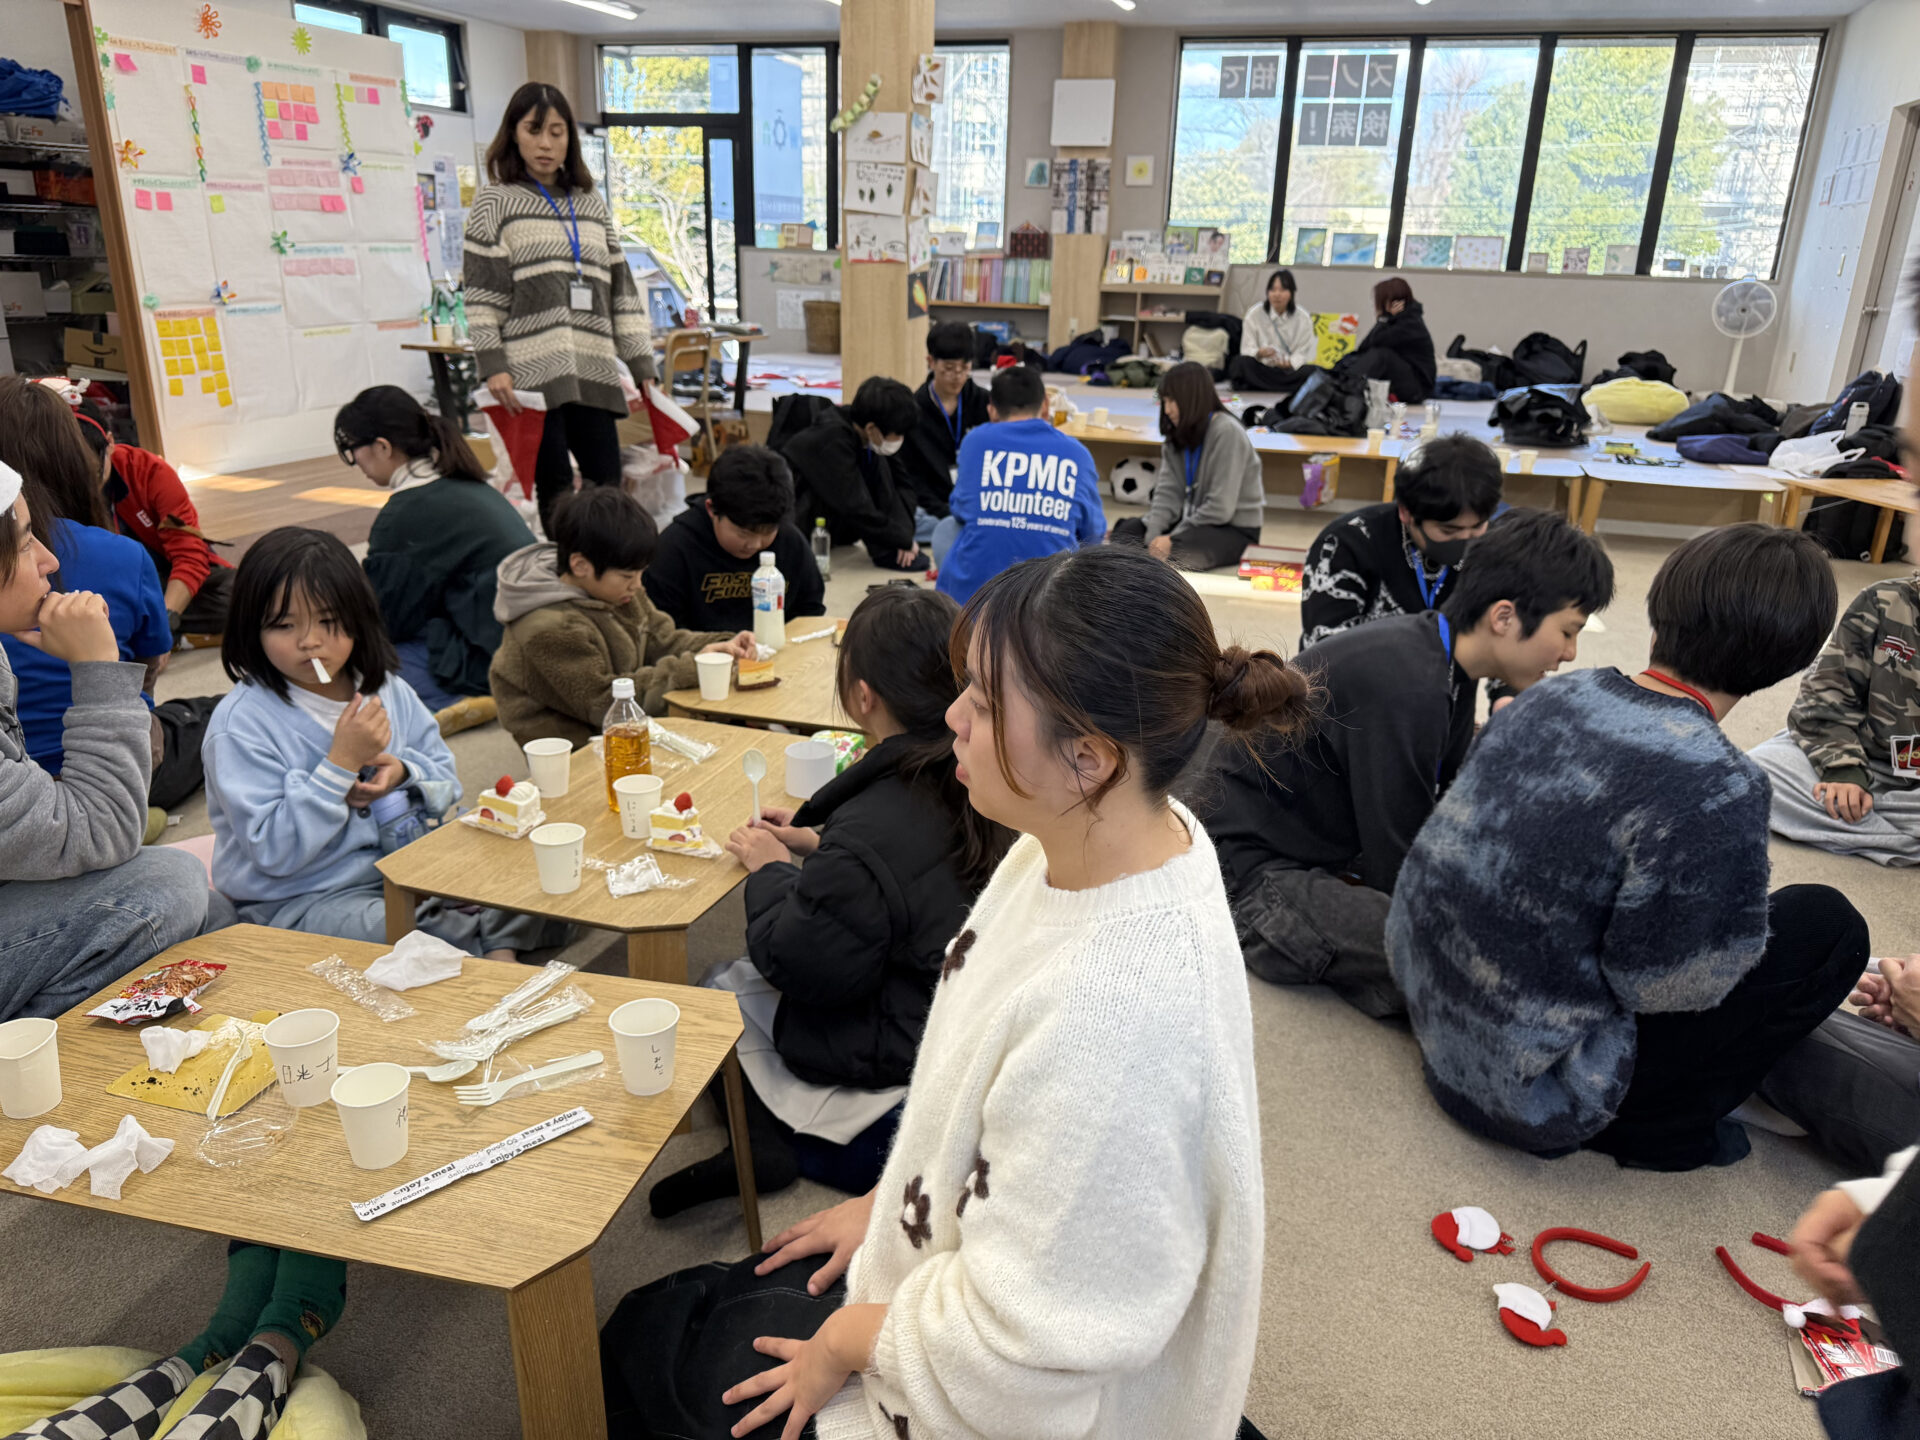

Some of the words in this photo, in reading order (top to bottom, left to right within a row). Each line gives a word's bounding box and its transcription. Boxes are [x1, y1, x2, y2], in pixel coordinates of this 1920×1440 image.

[981, 450, 1078, 499] KPMG
[980, 488, 1072, 521] volunteer
[1011, 516, 1027, 529] 125
[553, 1111, 578, 1124] enjoy
[490, 1151, 514, 1164] enjoy
[522, 1134, 546, 1149] meal
[393, 1180, 421, 1195] enjoy
[431, 1163, 456, 1179] meal
[448, 1161, 484, 1179] delicious
[391, 1186, 430, 1206] awesome
